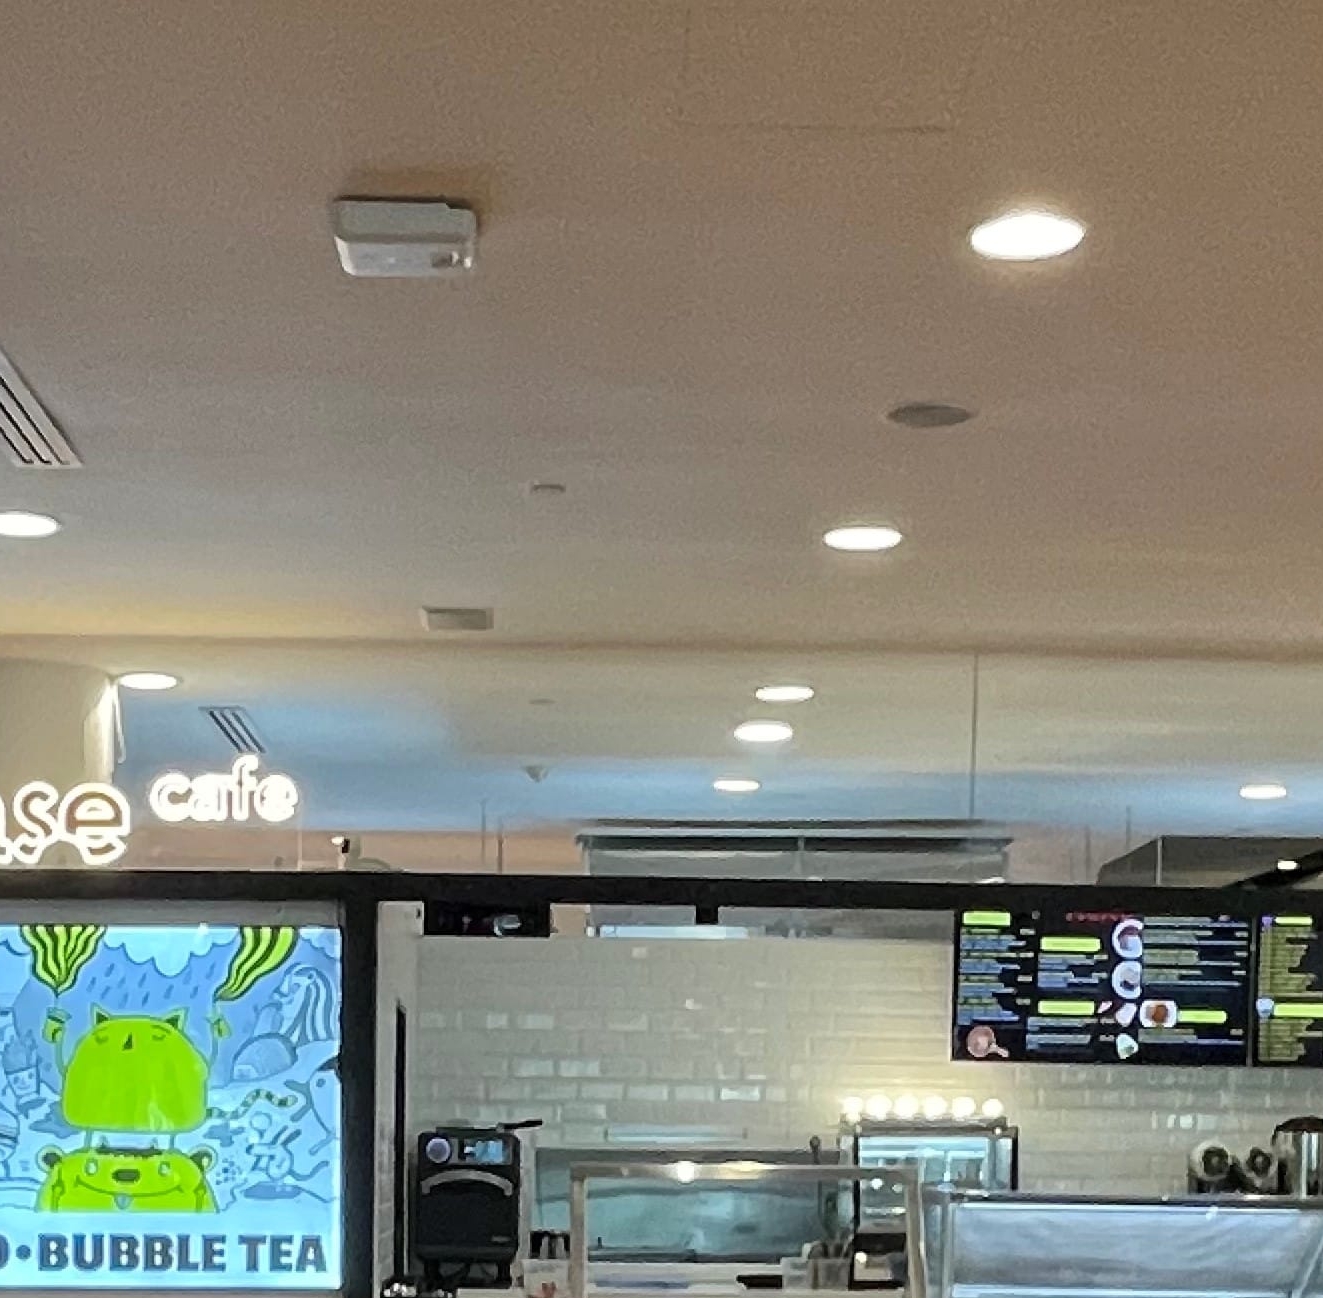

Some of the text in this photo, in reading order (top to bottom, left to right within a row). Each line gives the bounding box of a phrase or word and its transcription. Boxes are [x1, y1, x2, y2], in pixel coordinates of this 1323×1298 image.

[149, 755, 299, 822] cafe
[37, 1233, 226, 1272] BUBBLE
[238, 1234, 328, 1273] TEA
